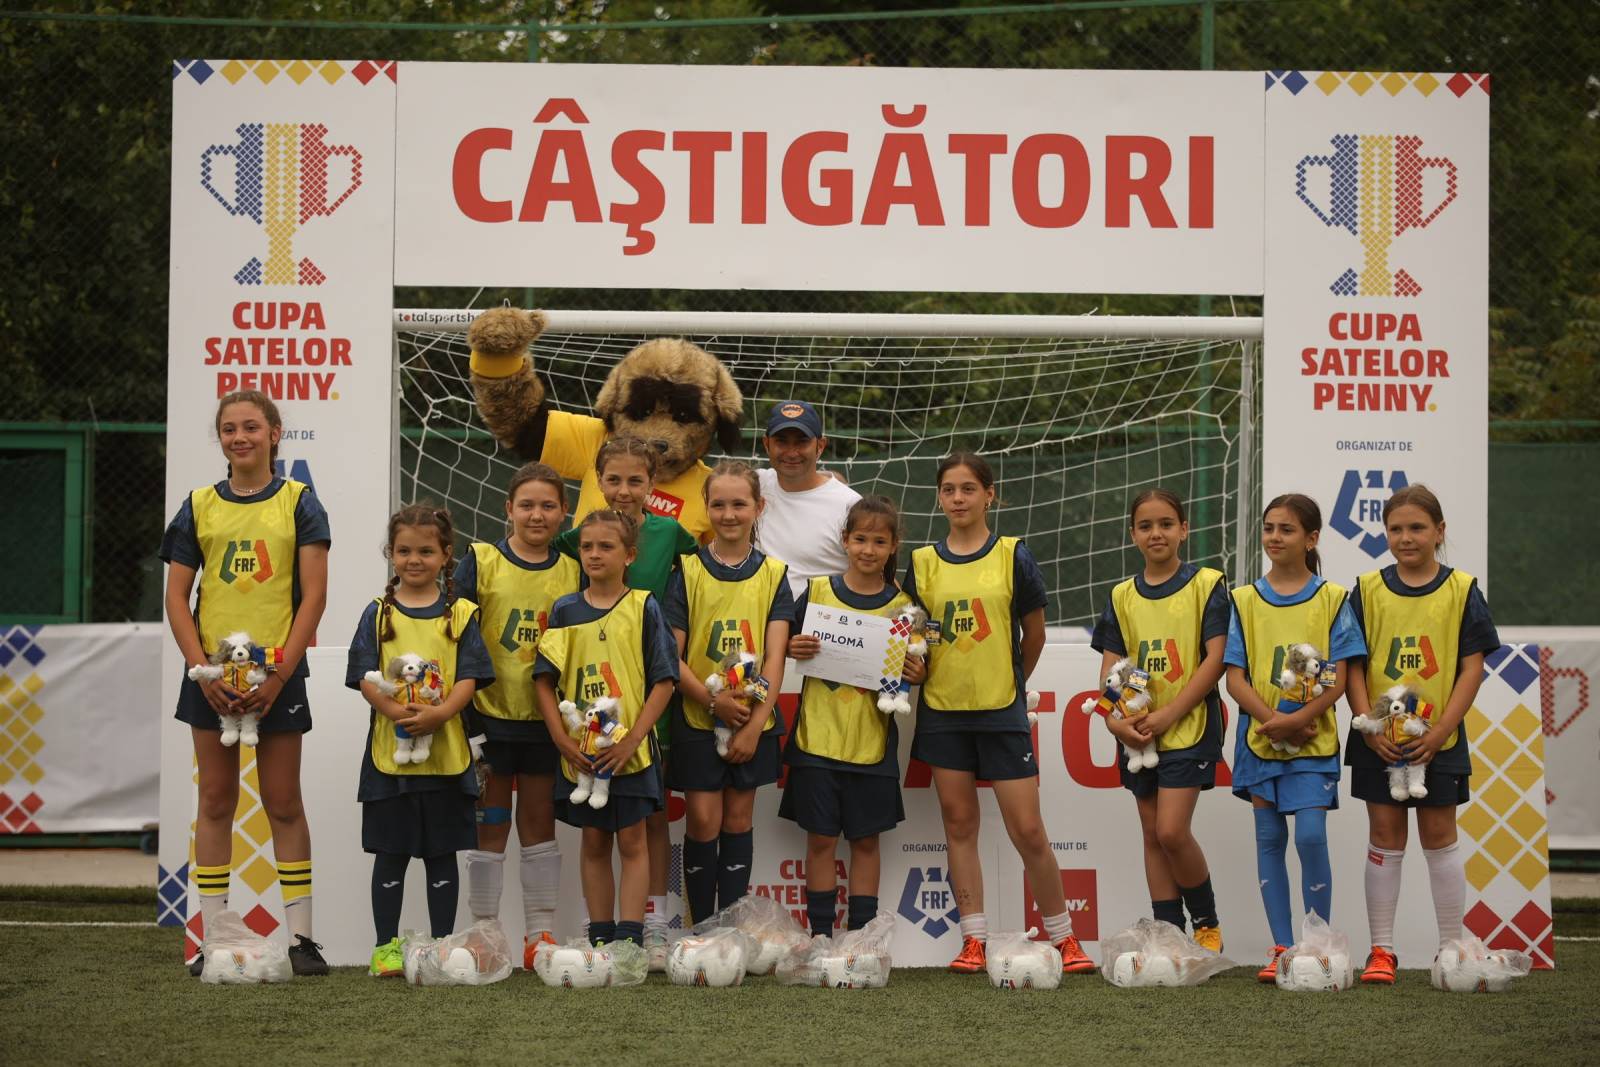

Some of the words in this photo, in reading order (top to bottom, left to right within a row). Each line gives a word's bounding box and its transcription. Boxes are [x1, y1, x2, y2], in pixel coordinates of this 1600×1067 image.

[232, 301, 326, 330] CUPA
[399, 312, 475, 324] totalsportsh
[1329, 312, 1423, 341] CUPA
[204, 337, 352, 366] SATELOR
[1301, 348, 1450, 377] SATELOR
[1314, 383, 1437, 412] PENNY.
[301, 430, 315, 440] DE
[1336, 440, 1396, 451] ORGANIZAT
[1399, 441, 1413, 451] DE
[645, 494, 677, 516] NNY.
[1359, 499, 1385, 522] FR
[234, 557, 256, 573] FRF
[955, 616, 974, 633] FRF
[518, 627, 539, 643] FRF
[722, 637, 743, 651] FRF
[1147, 656, 1167, 673] FRF
[1400, 653, 1422, 670] FRF
[584, 681, 605, 700] FRF
[902, 843, 948, 853] ORGANIZA
[1076, 843, 1088, 851] DE
[780, 859, 848, 880] CUA
[921, 890, 949, 909] FRF
